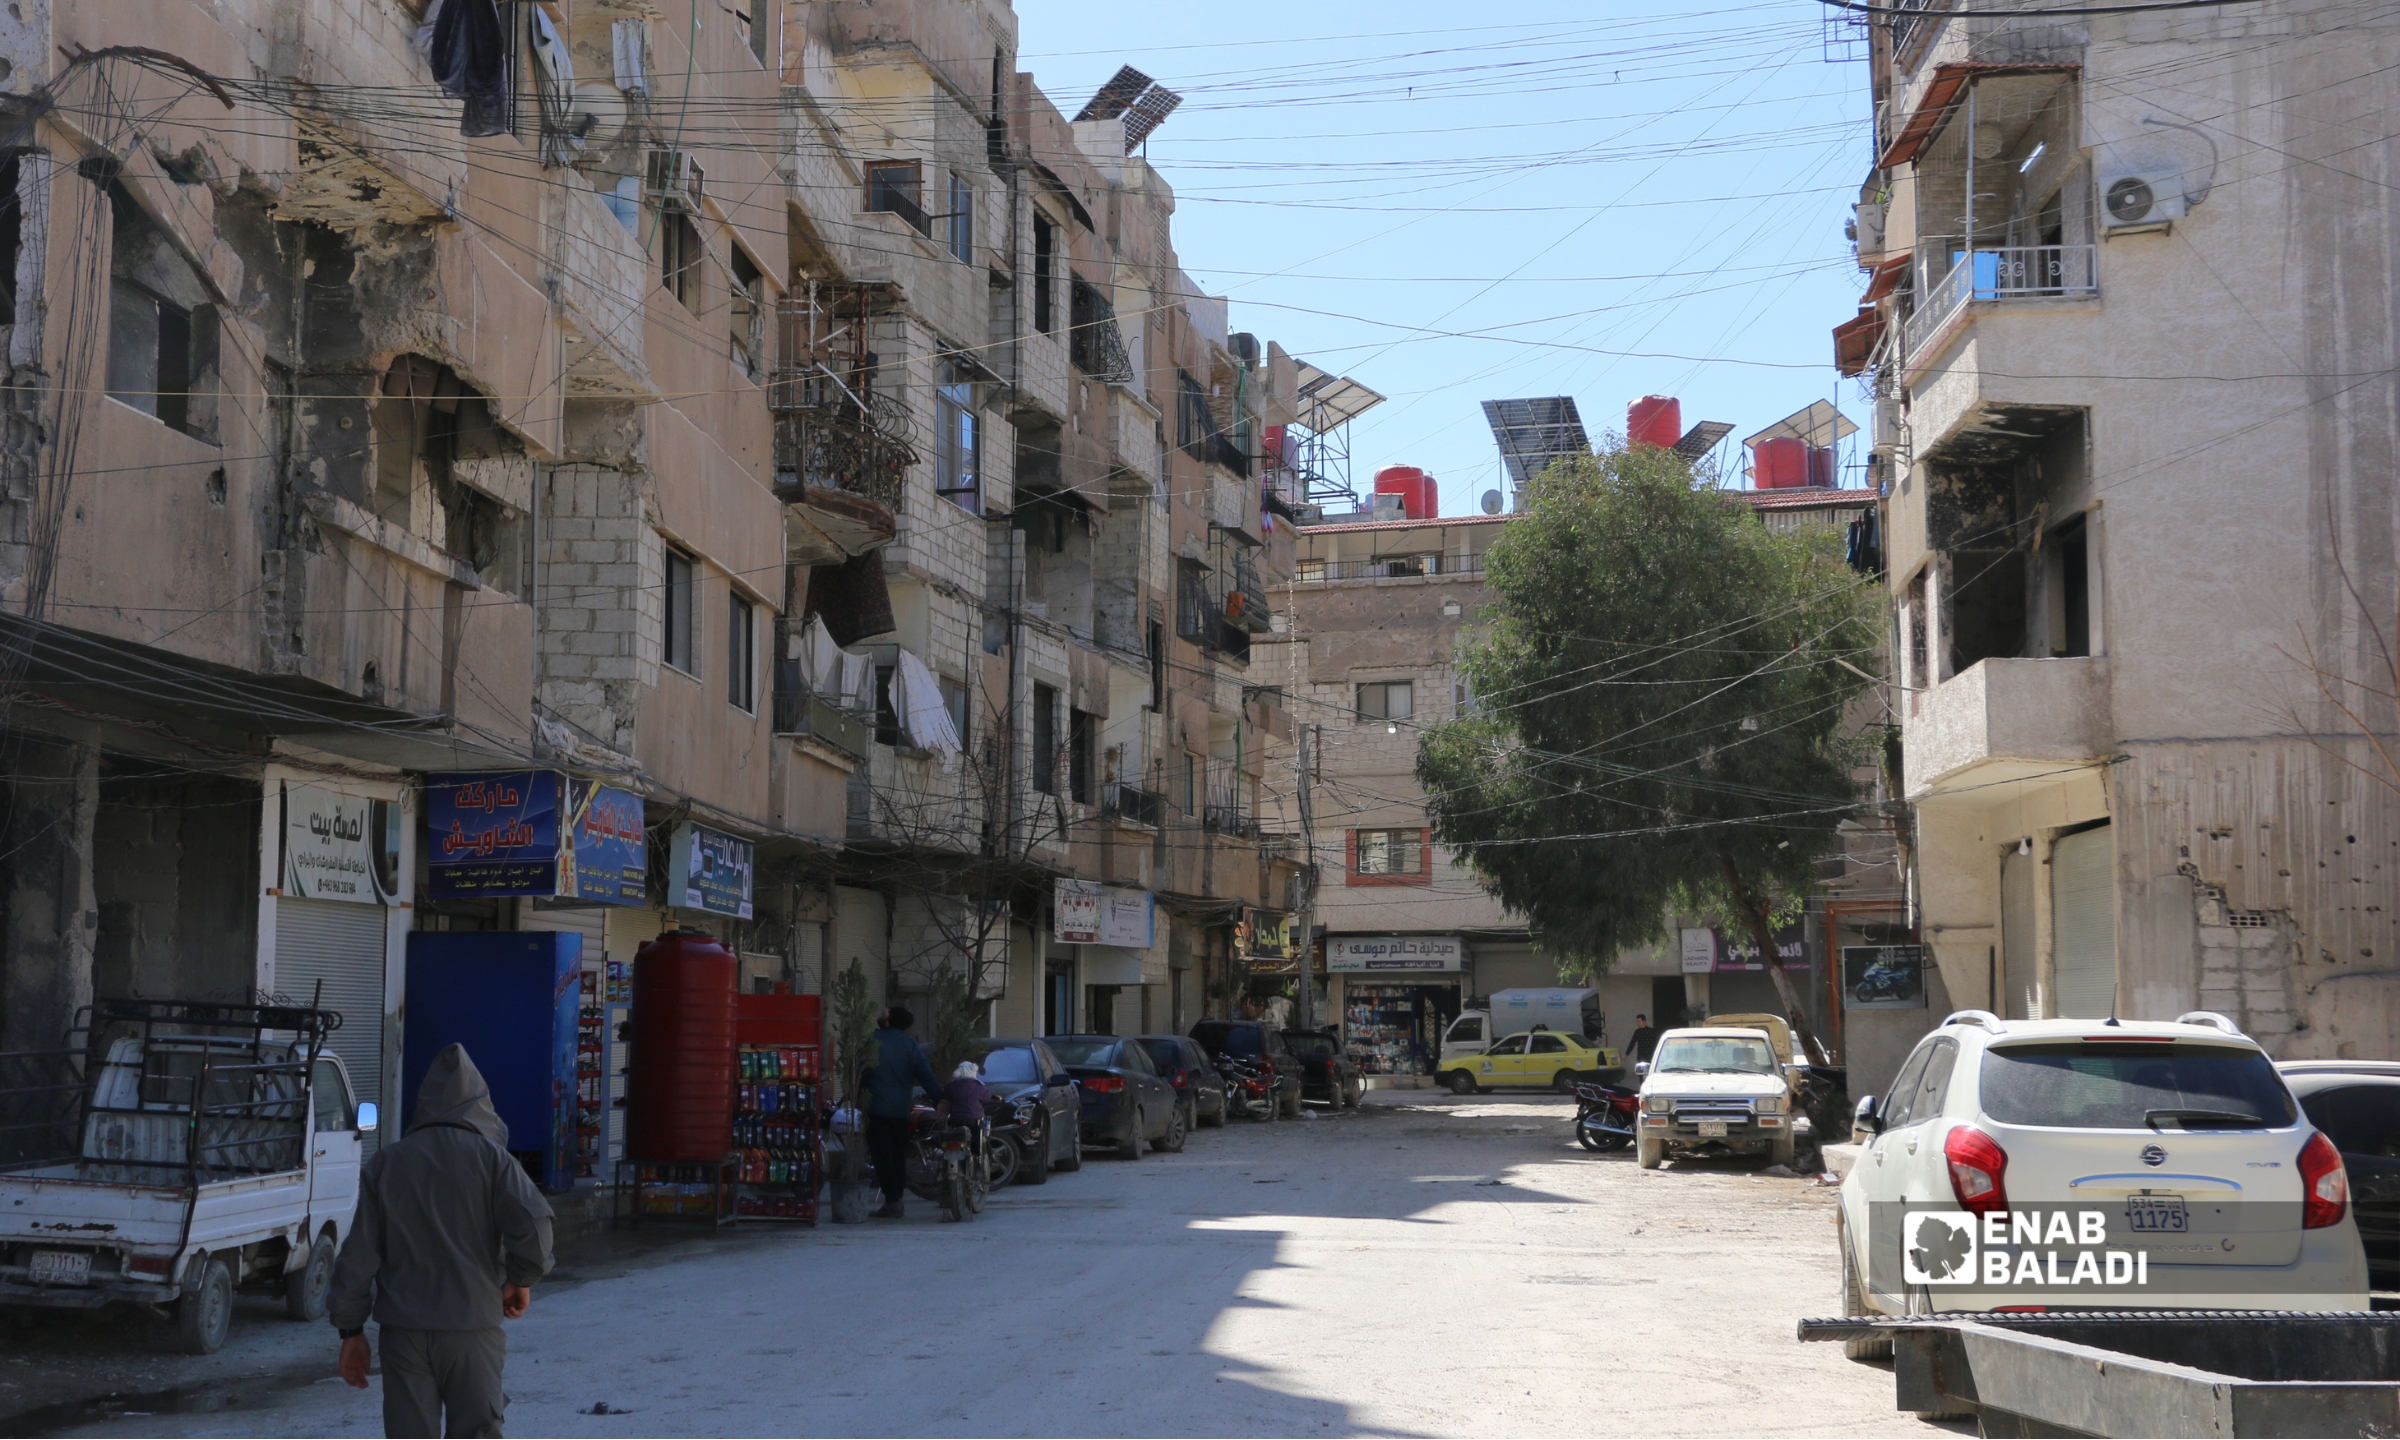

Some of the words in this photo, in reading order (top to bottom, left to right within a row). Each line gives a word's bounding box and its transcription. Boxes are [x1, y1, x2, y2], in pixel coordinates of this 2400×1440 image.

[455, 781, 519, 814] ماركت
[310, 811, 332, 845] بيت
[333, 805, 364, 842] لمسة
[442, 816, 534, 856] الشاويش
[717, 838, 744, 877] مرعي
[1349, 943, 1386, 958] موسى
[1389, 940, 1417, 957] حاتم
[1419, 941, 1454, 956] صيدلية
[2132, 1198, 2153, 1209] 534
[2134, 1210, 2183, 1229] 1175
